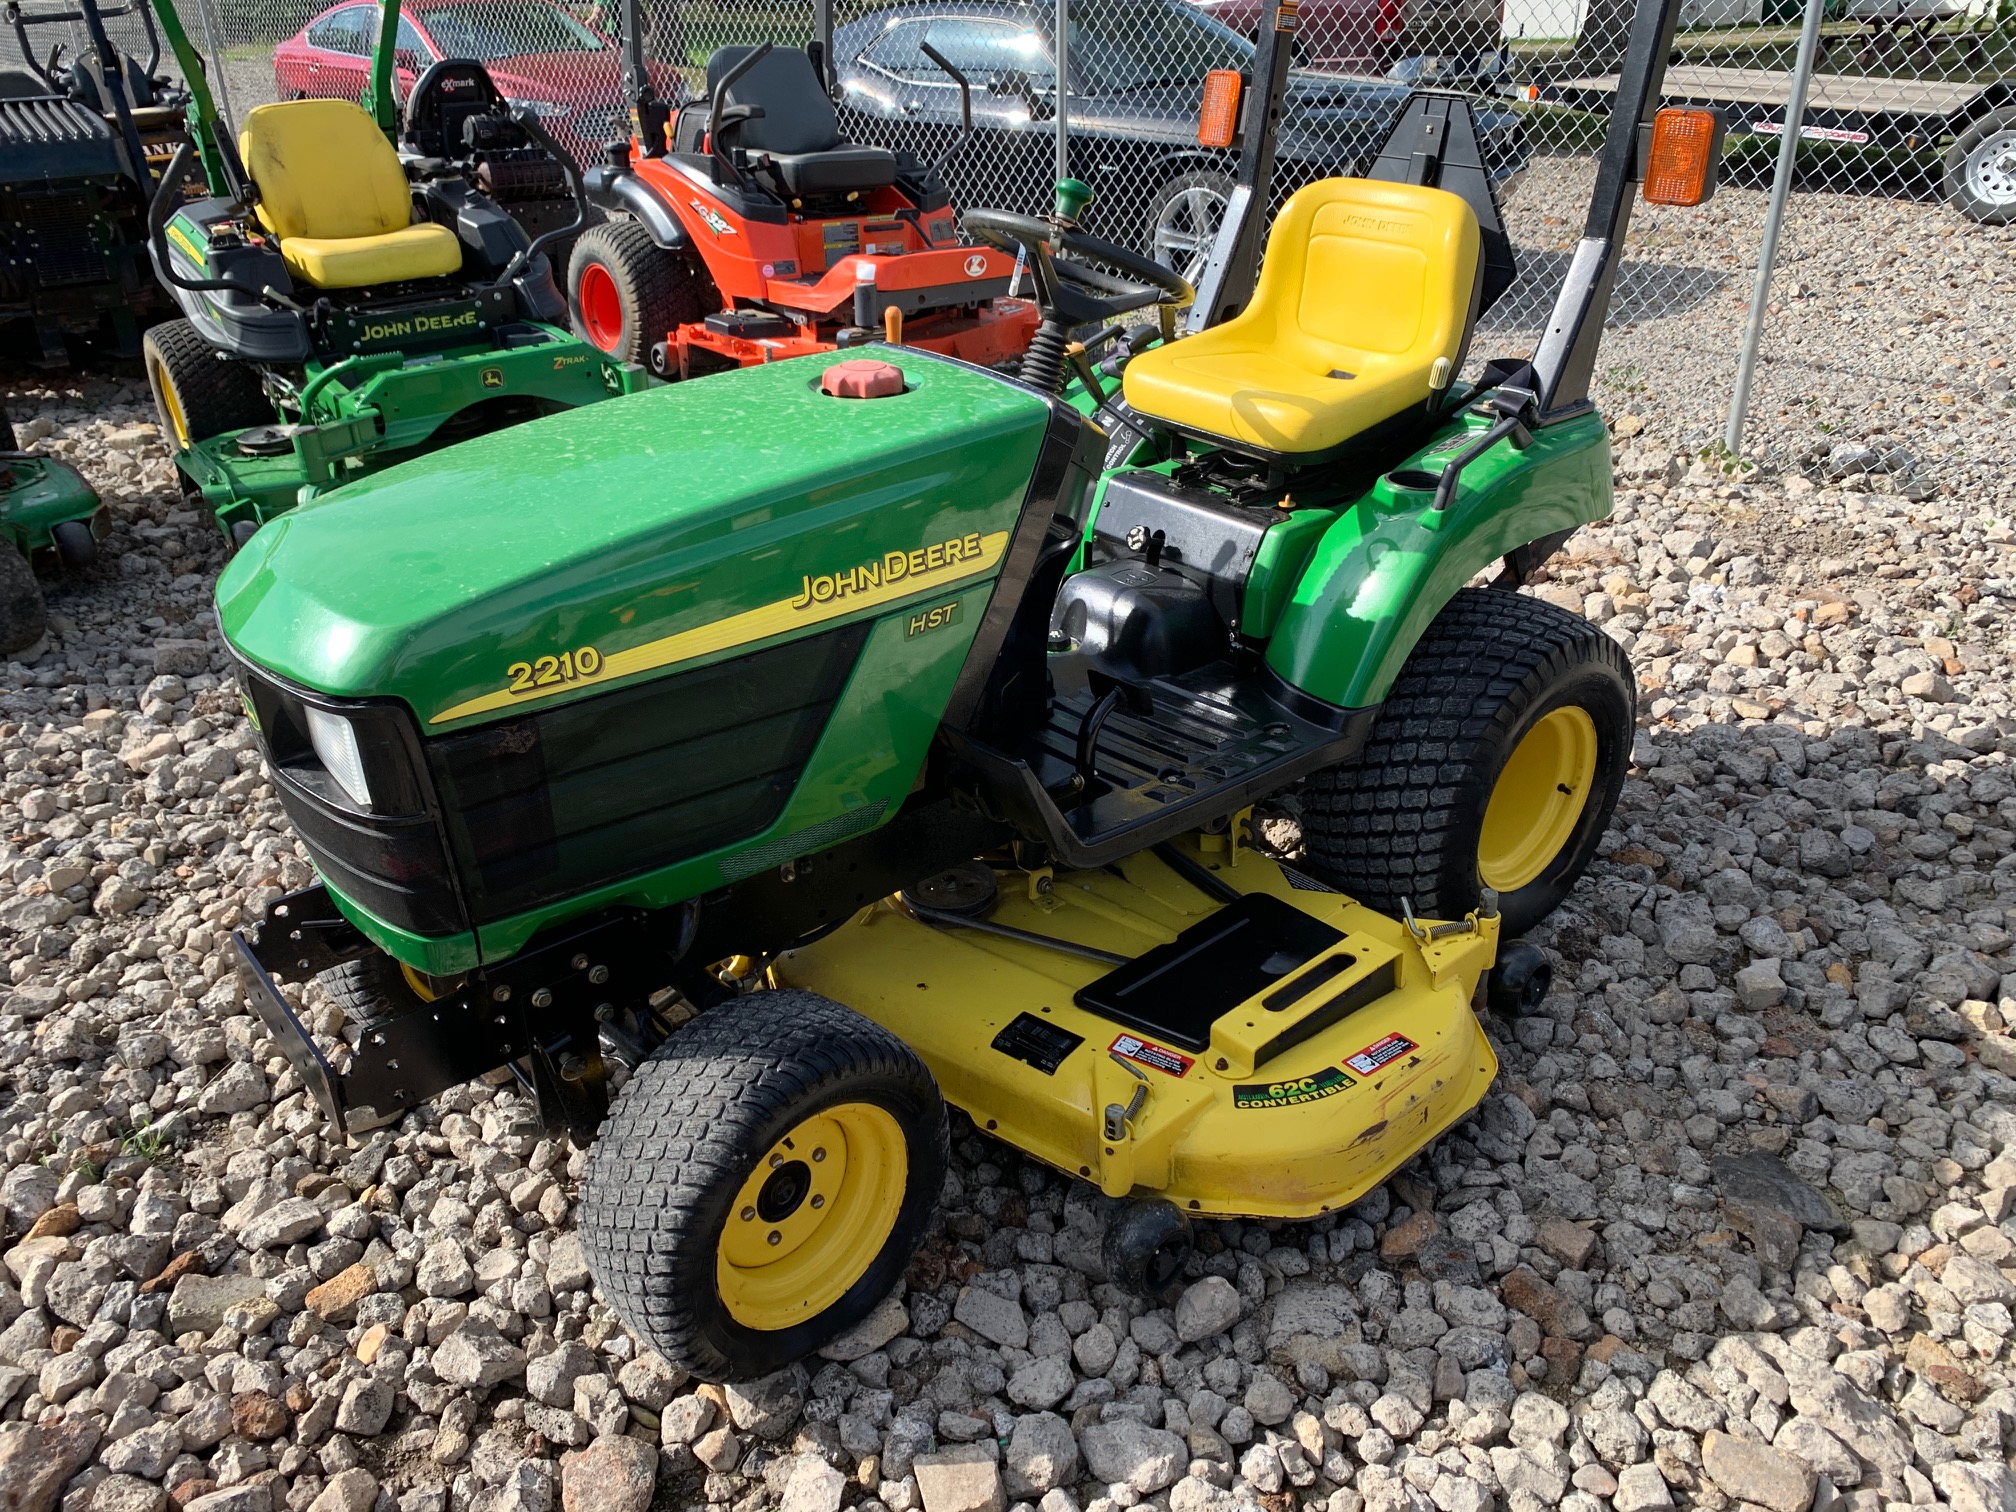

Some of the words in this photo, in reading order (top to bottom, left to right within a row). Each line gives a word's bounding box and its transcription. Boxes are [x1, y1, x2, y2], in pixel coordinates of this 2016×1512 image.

[141, 141, 180, 156] ANK
[361, 321, 411, 341] JOHN
[415, 311, 477, 332] DEERE
[1101, 415, 1115, 428] N
[1106, 443, 1127, 470] CONTROL
[792, 561, 882, 611] JOHN
[884, 532, 983, 584] DEERE
[908, 601, 959, 637] HST
[507, 645, 606, 697] 2210
[1158, 1047, 1182, 1060] DANGER
[1237, 1078, 1355, 1109] CONVERTIBLE
[1268, 1077, 1318, 1099] 62C
